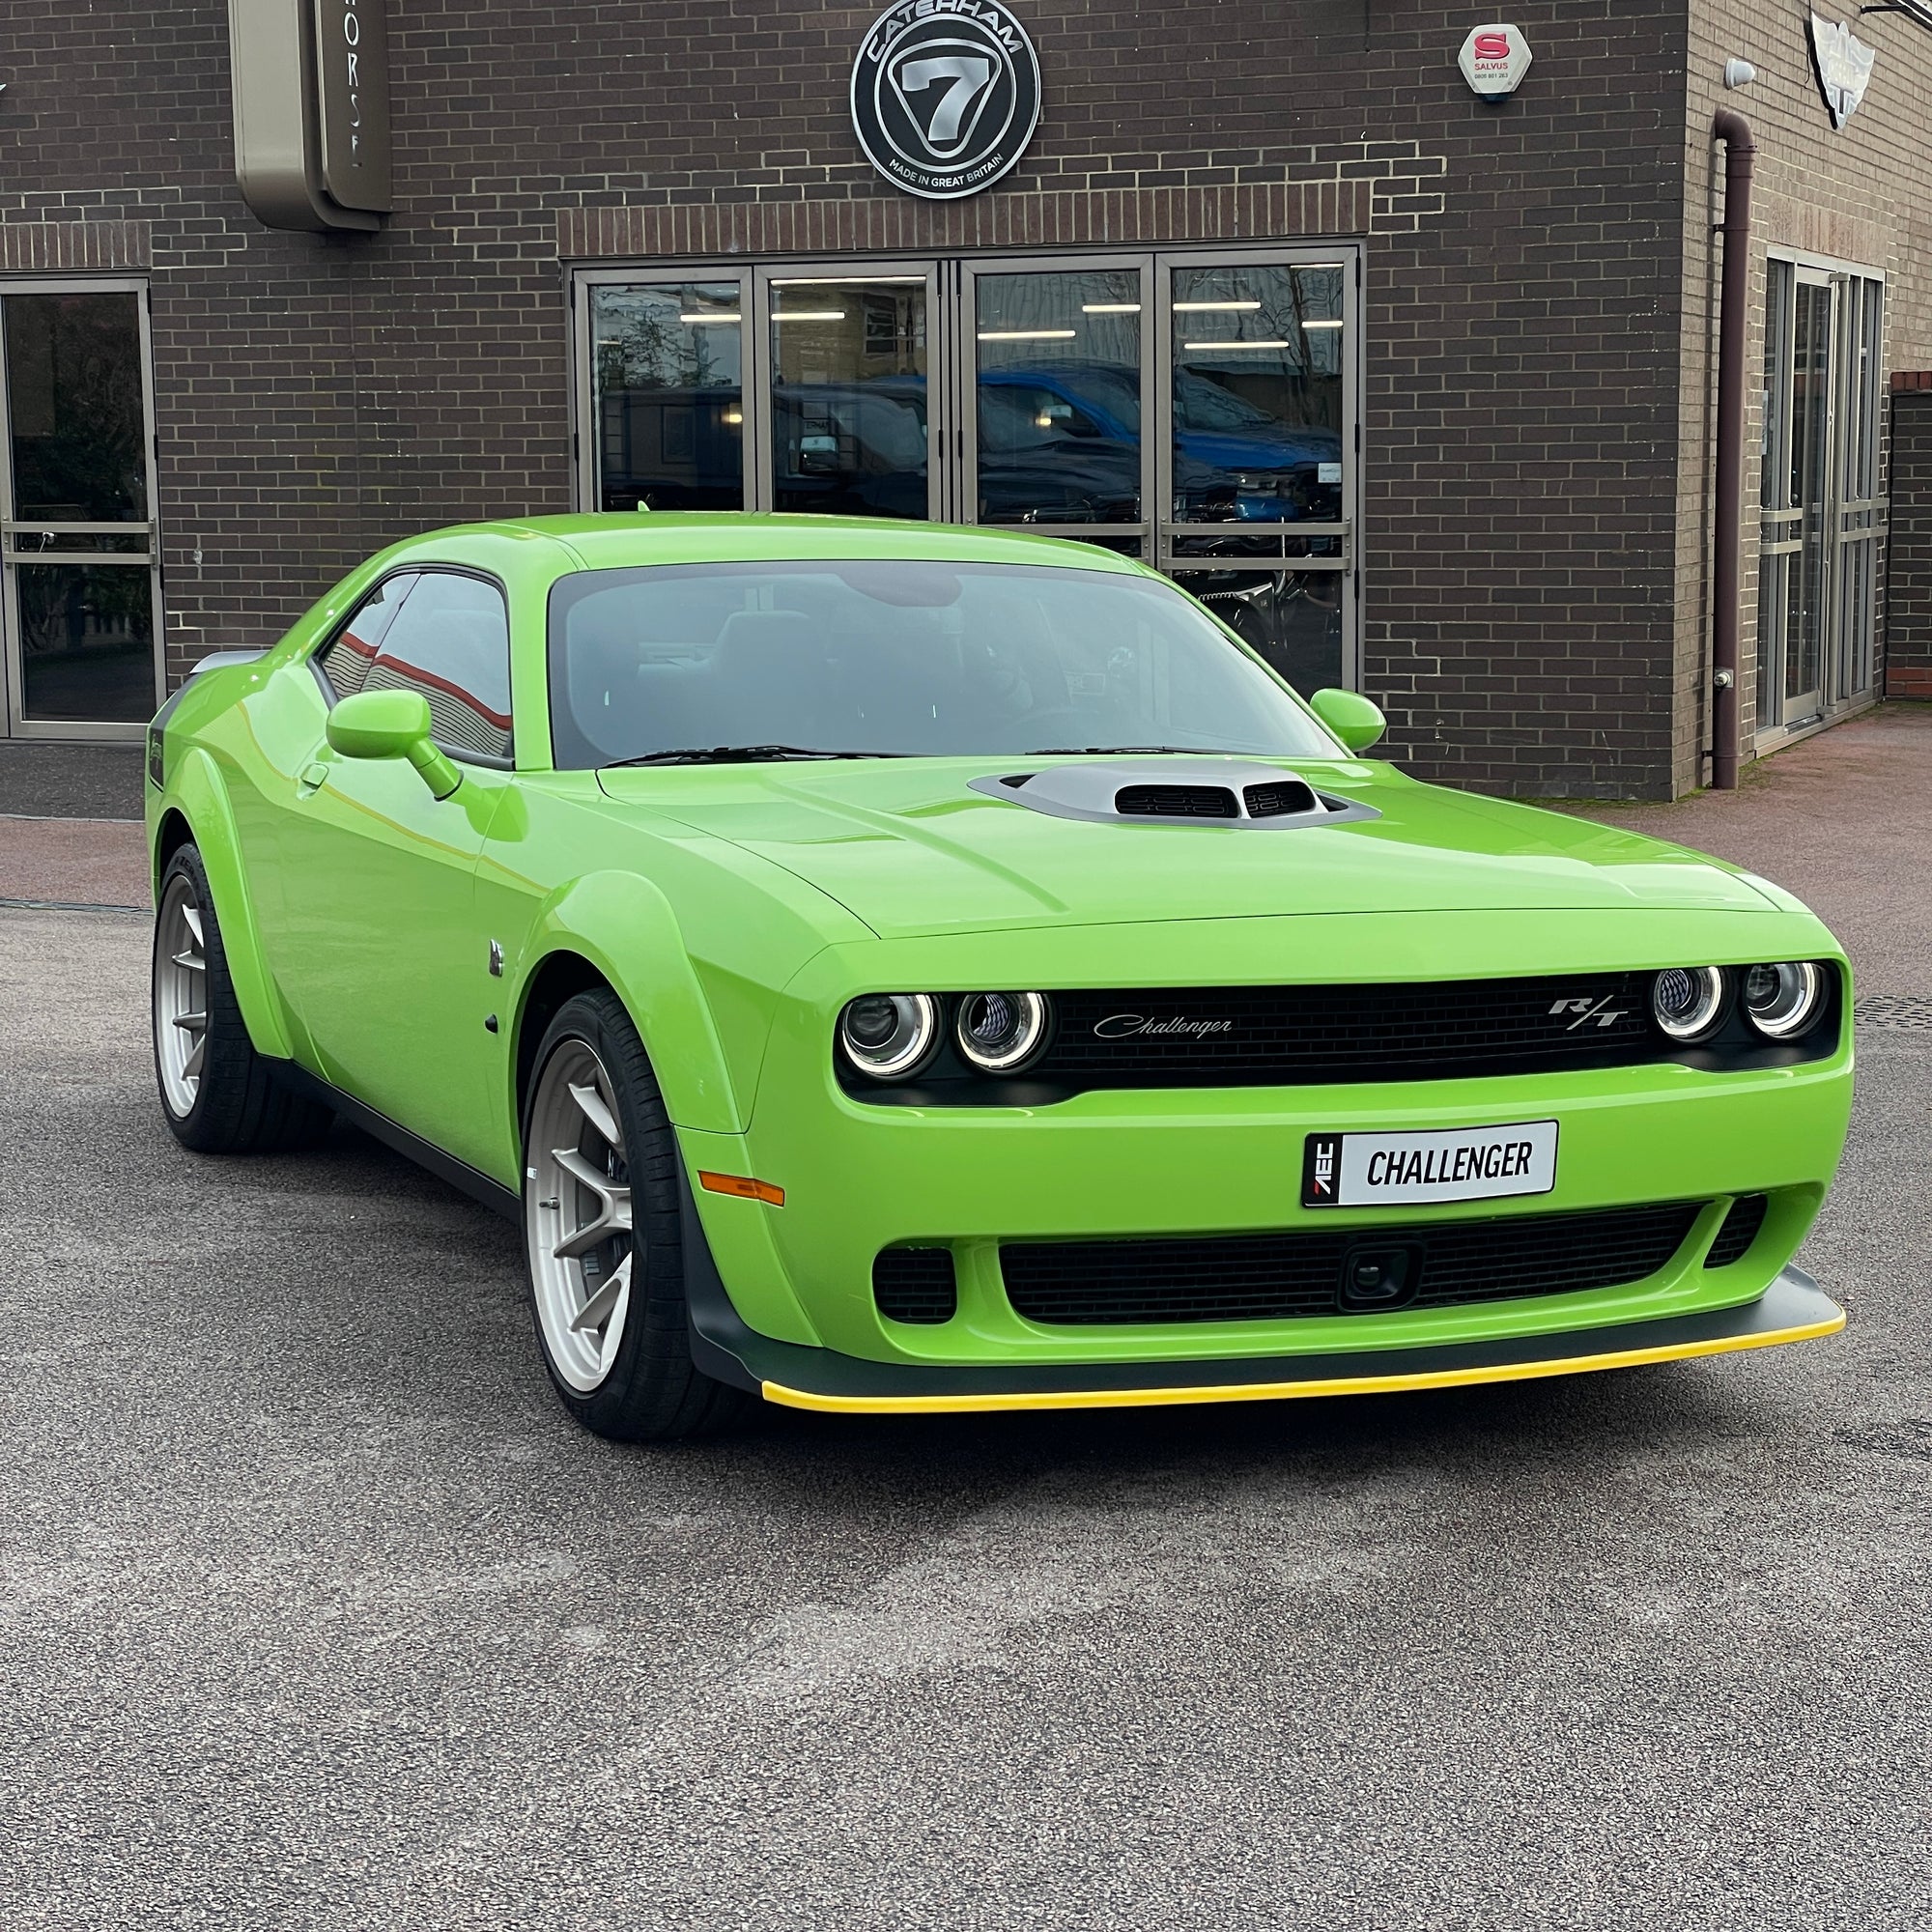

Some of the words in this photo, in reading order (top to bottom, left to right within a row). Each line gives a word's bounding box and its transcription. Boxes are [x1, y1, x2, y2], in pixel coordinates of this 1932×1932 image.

[1474, 62, 1509, 71] SALVUS
[901, 56, 990, 142] 7
[889, 158, 917, 182] MADE
[918, 175, 929, 186] IN
[931, 175, 965, 187] GREAT
[966, 154, 1005, 183] BRITAIN
[1094, 1014, 1233, 1039] Challenger
[1548, 994, 1629, 1031] R/T
[1314, 1143, 1334, 1196] AEC
[1367, 1141, 1533, 1186] CHALLENGER
